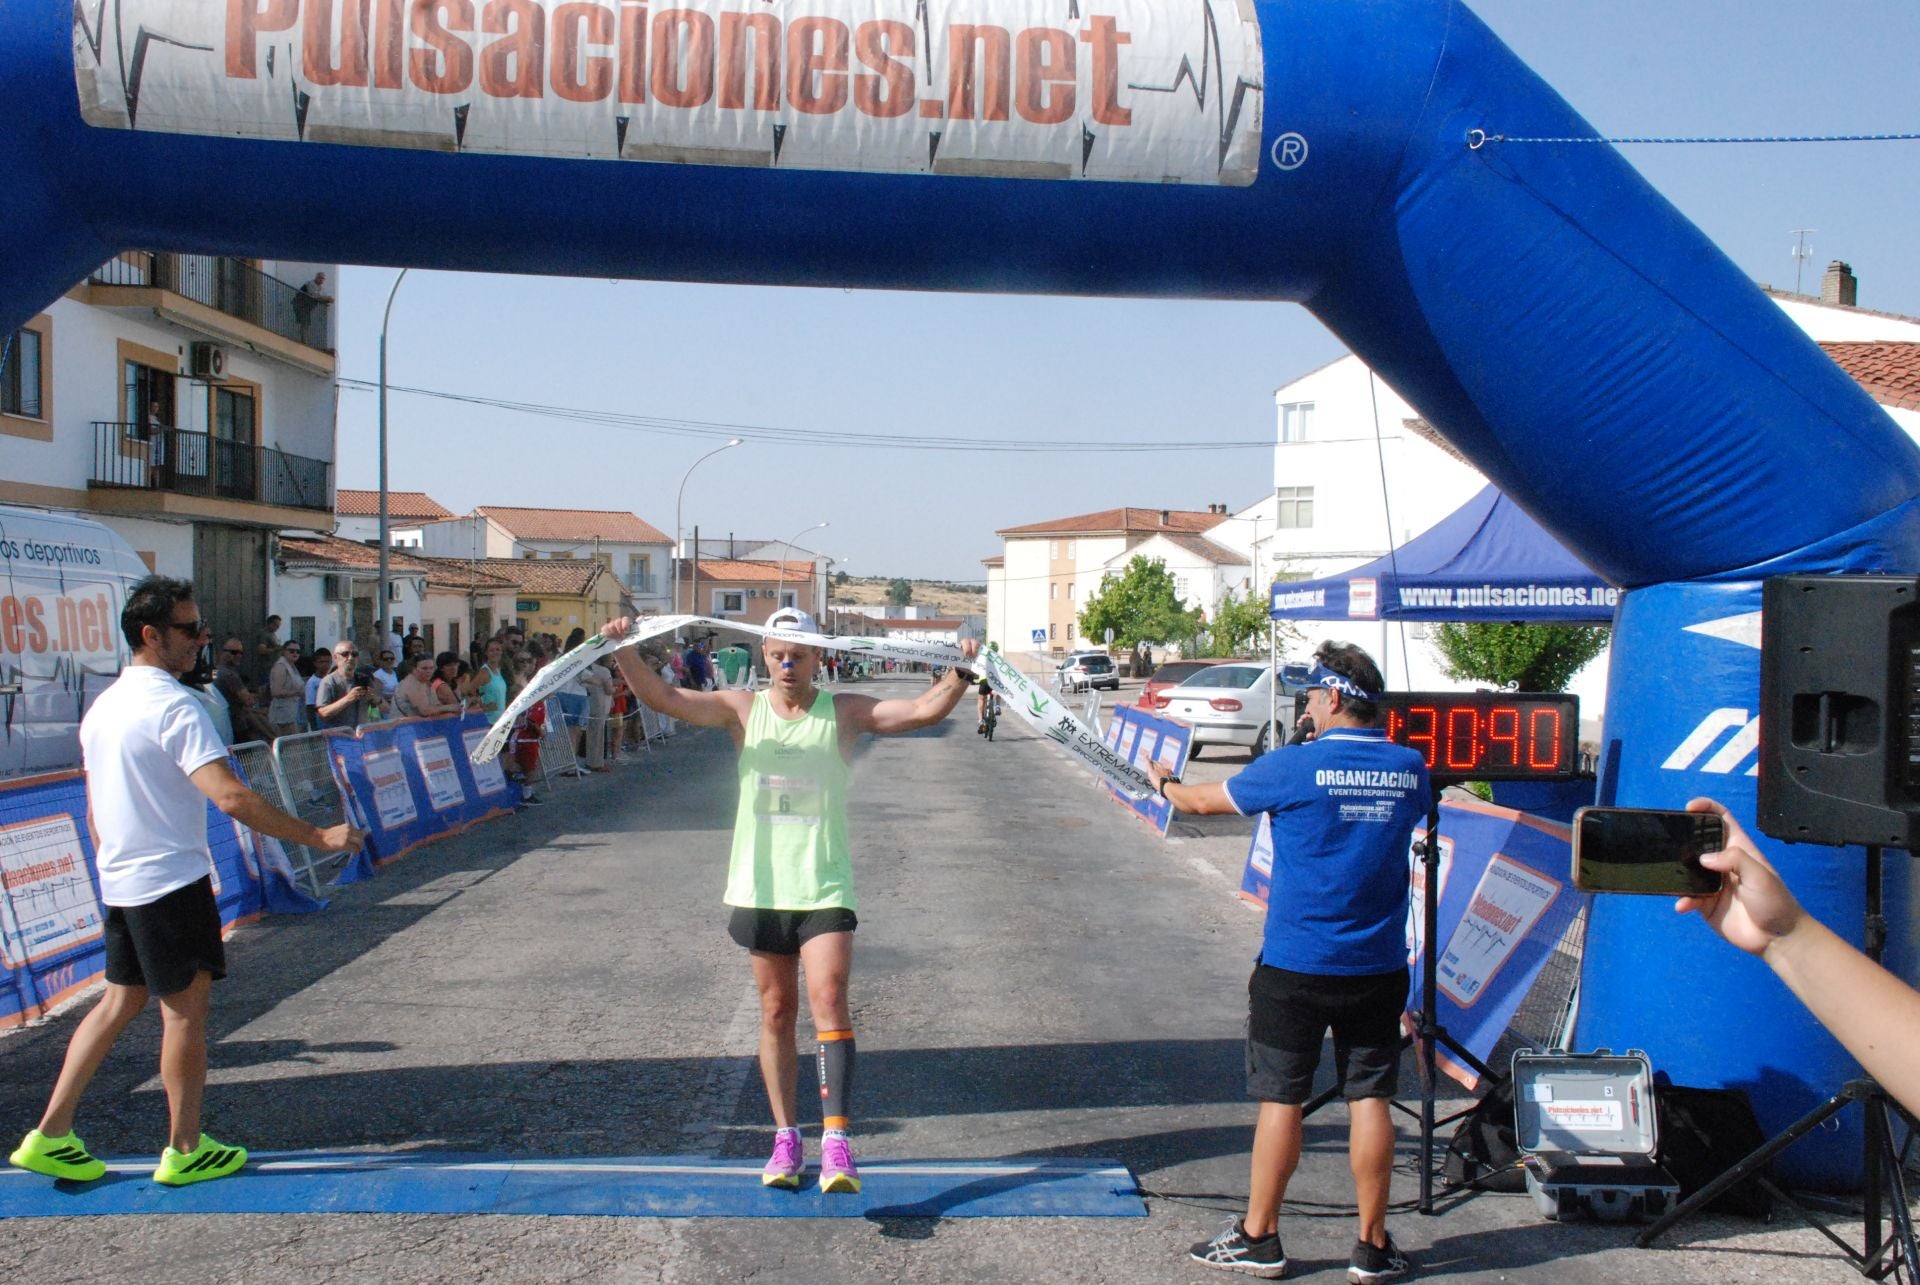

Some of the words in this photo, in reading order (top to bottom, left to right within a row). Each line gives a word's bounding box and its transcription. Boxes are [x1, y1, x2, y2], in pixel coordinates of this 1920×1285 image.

[226, 0, 1131, 126] Pulsaciones.net
[24, 538, 101, 566] deportivos
[1315, 769, 1418, 790] ORGANIZACIÓN
[1328, 788, 1361, 796] EVENTOS
[1362, 789, 1406, 798] DEPORTIVOS
[779, 794, 791, 813] 6
[1606, 1087, 1612, 1095] 3
